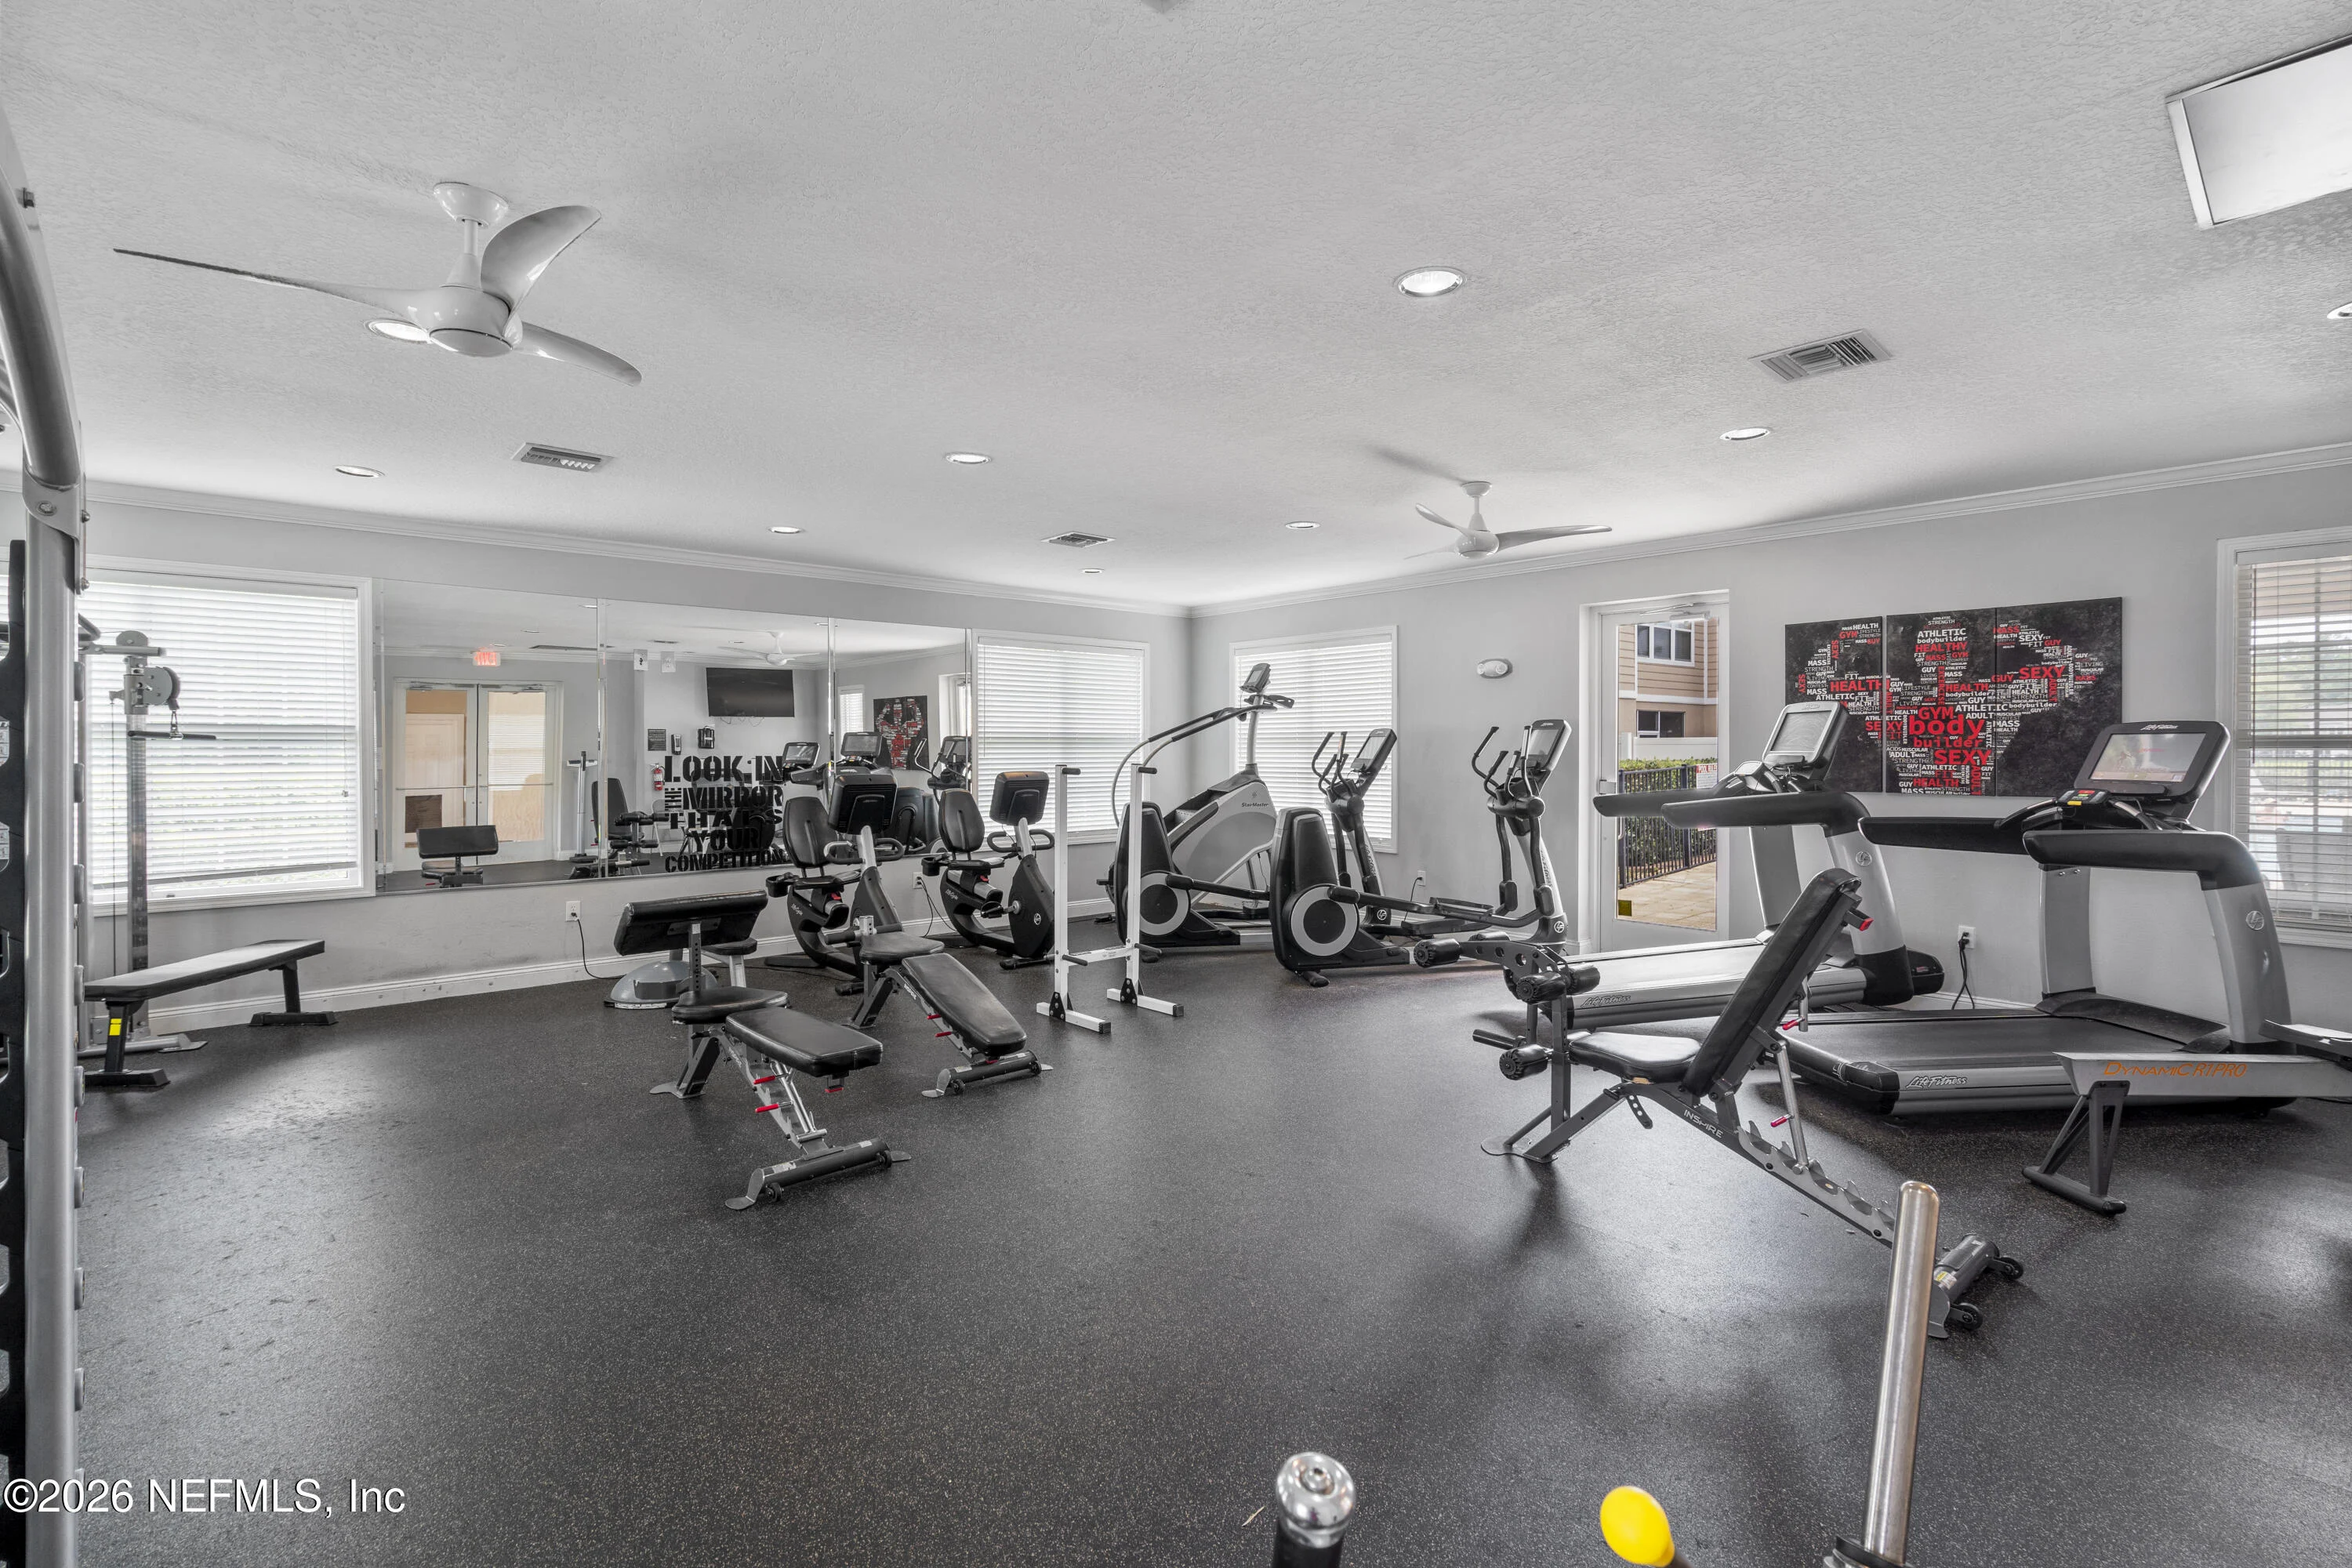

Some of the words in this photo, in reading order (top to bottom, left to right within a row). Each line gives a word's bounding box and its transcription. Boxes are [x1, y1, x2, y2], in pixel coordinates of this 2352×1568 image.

[1839, 630, 1857, 639] GYM
[1918, 628, 1966, 638] ATHLETIC
[1831, 640, 1839, 659] SEXY
[1915, 641, 1968, 652] HEALTHY
[2019, 666, 2066, 680] SEXY
[1830, 679, 1890, 691] HEALTH
[1945, 683, 1989, 691] HEALTH
[2049, 677, 2057, 702] ADULT
[1918, 706, 1954, 720] GYM
[1865, 720, 1904, 731] SEXY
[1909, 713, 1986, 740] body
[1914, 735, 1983, 748] builder
[1933, 749, 1991, 765] SEXY
[665, 756, 743, 782] LOOK
[755, 756, 783, 782] IN
[1935, 770, 1955, 779] FIT
[1913, 777, 1959, 787] HEALTH
[1970, 764, 1981, 795] ADULT
[683, 786, 783, 810] MIRROR
[693, 827, 760, 852] YOUR
[665, 849, 787, 873] COMPETITION
[1683, 1109, 1724, 1138] INSPIRE
